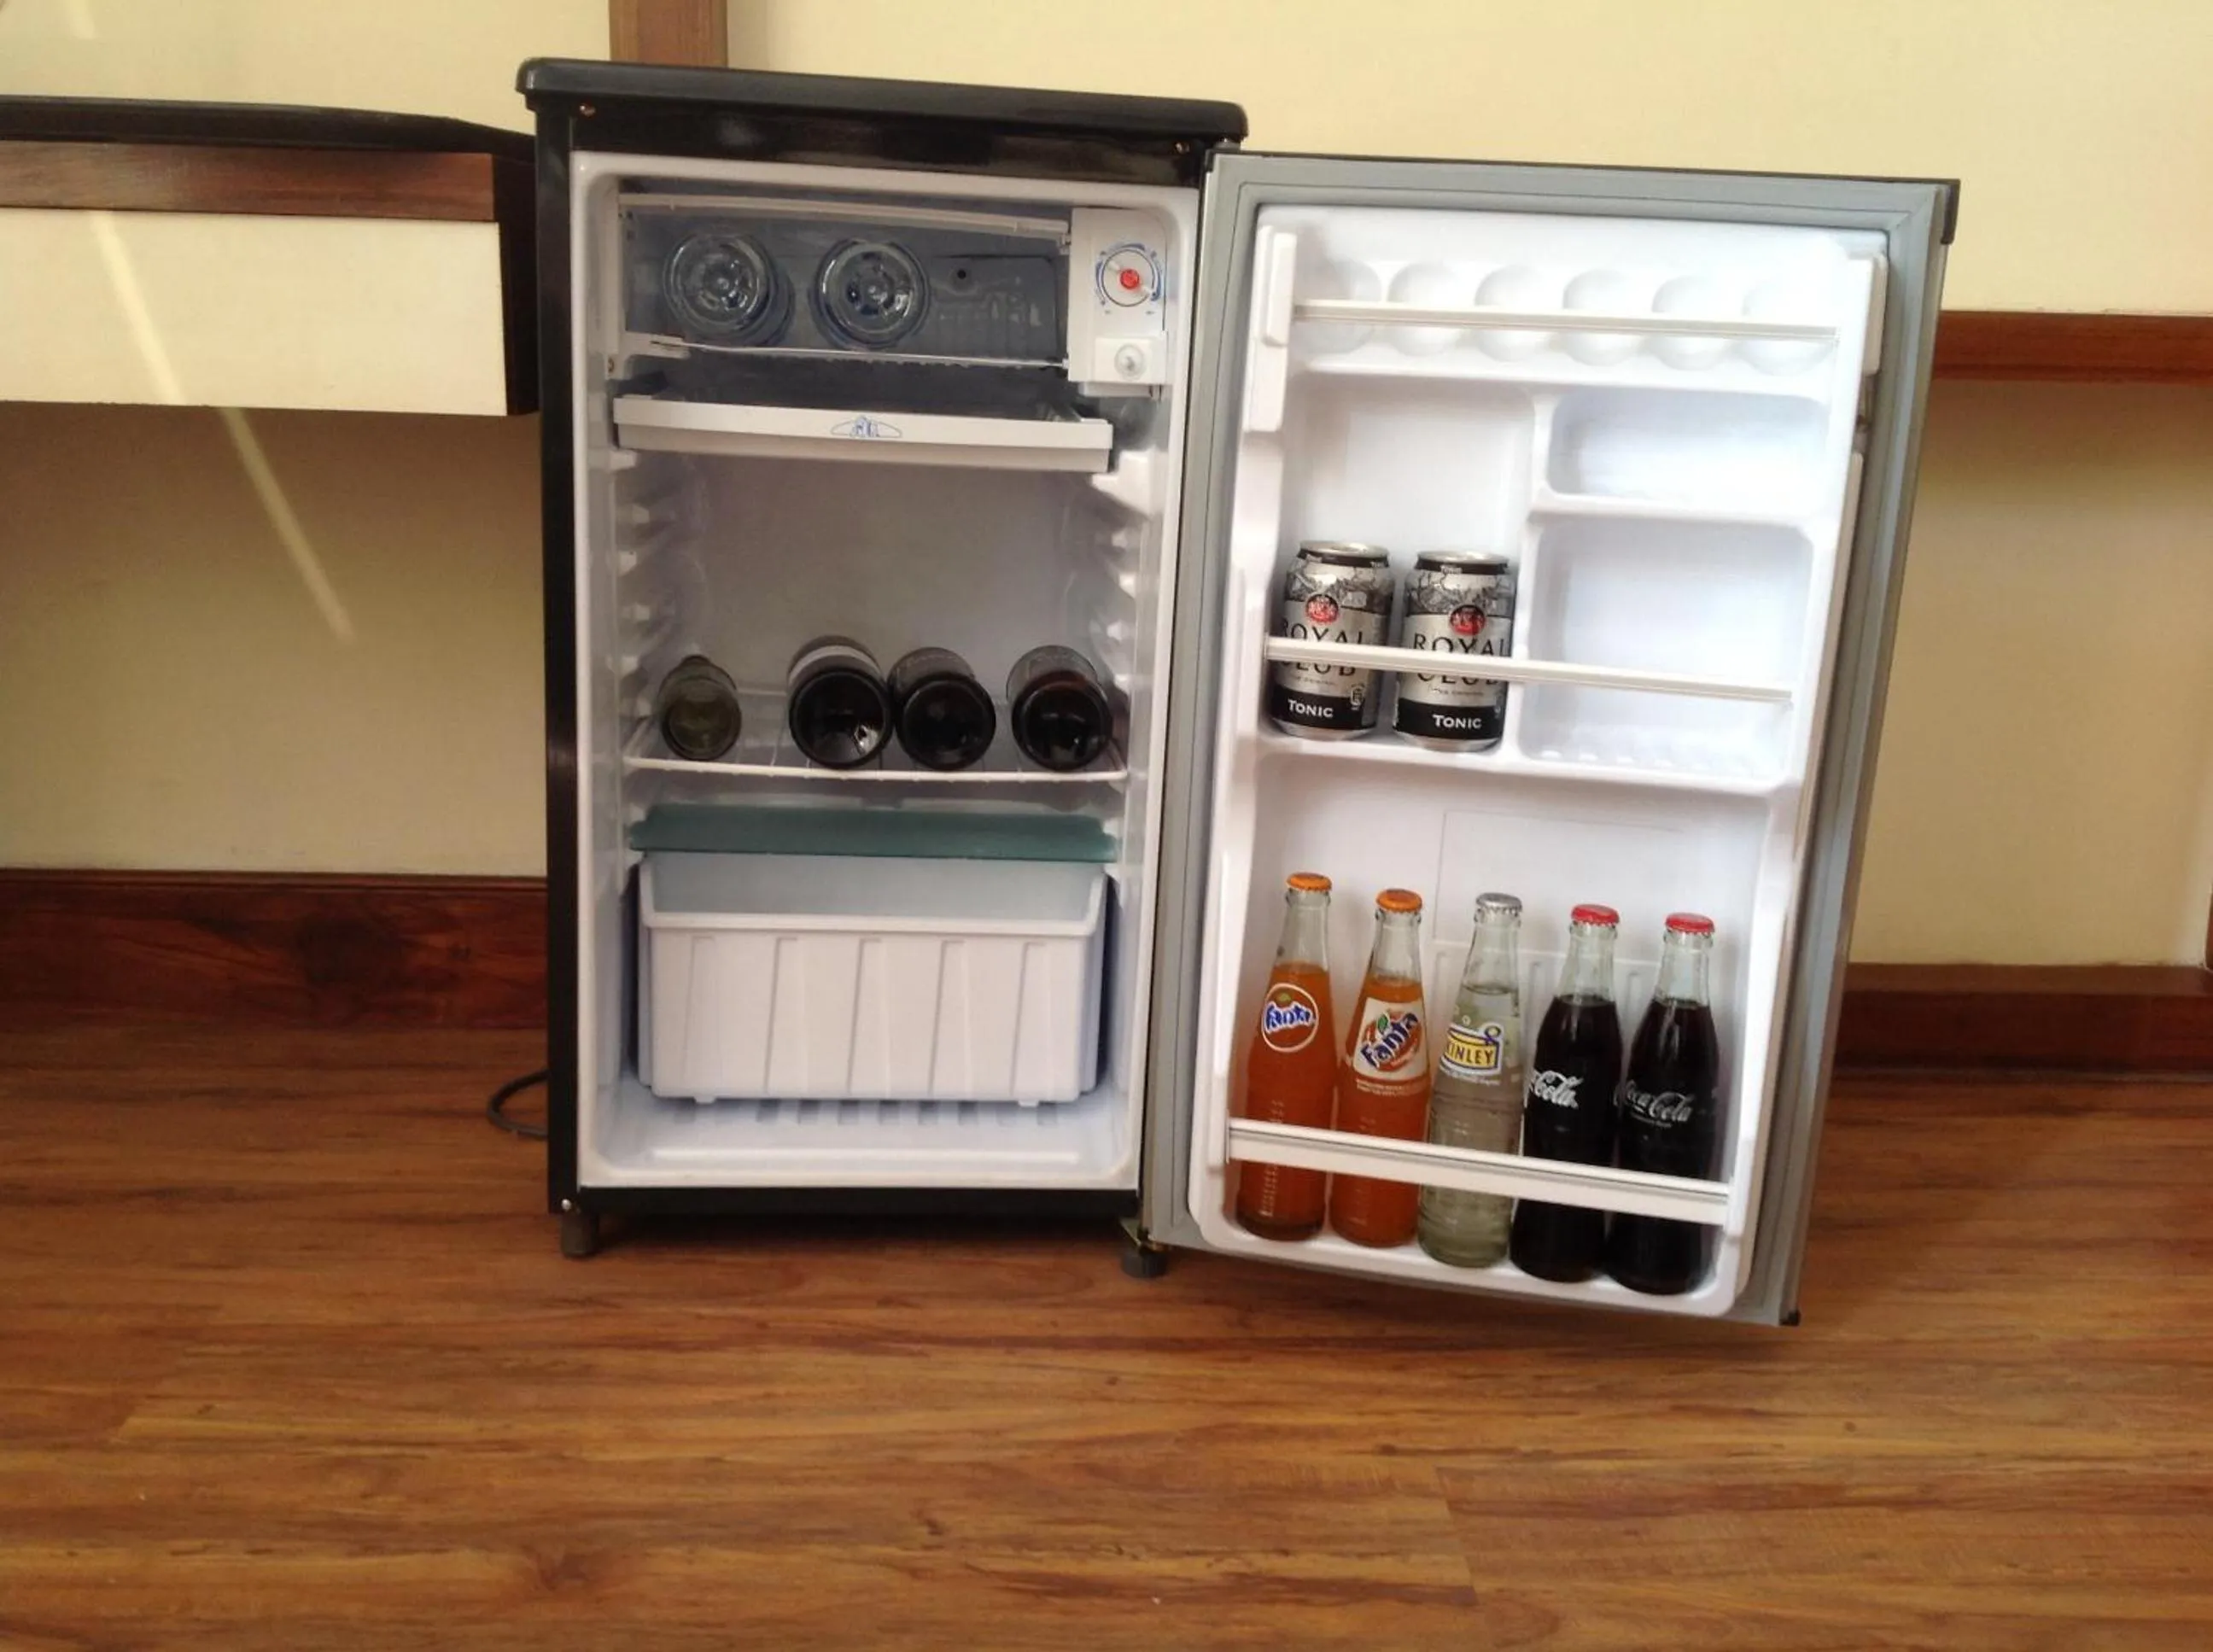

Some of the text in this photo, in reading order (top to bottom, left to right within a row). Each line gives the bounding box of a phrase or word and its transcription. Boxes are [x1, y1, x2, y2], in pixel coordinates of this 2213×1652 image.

[1288, 698, 1334, 718] TONIC
[1432, 714, 1483, 730] TONIC
[1265, 1002, 1316, 1034] Fanta
[1360, 1012, 1419, 1068] Fanta
[1447, 1041, 1493, 1065] INLEY
